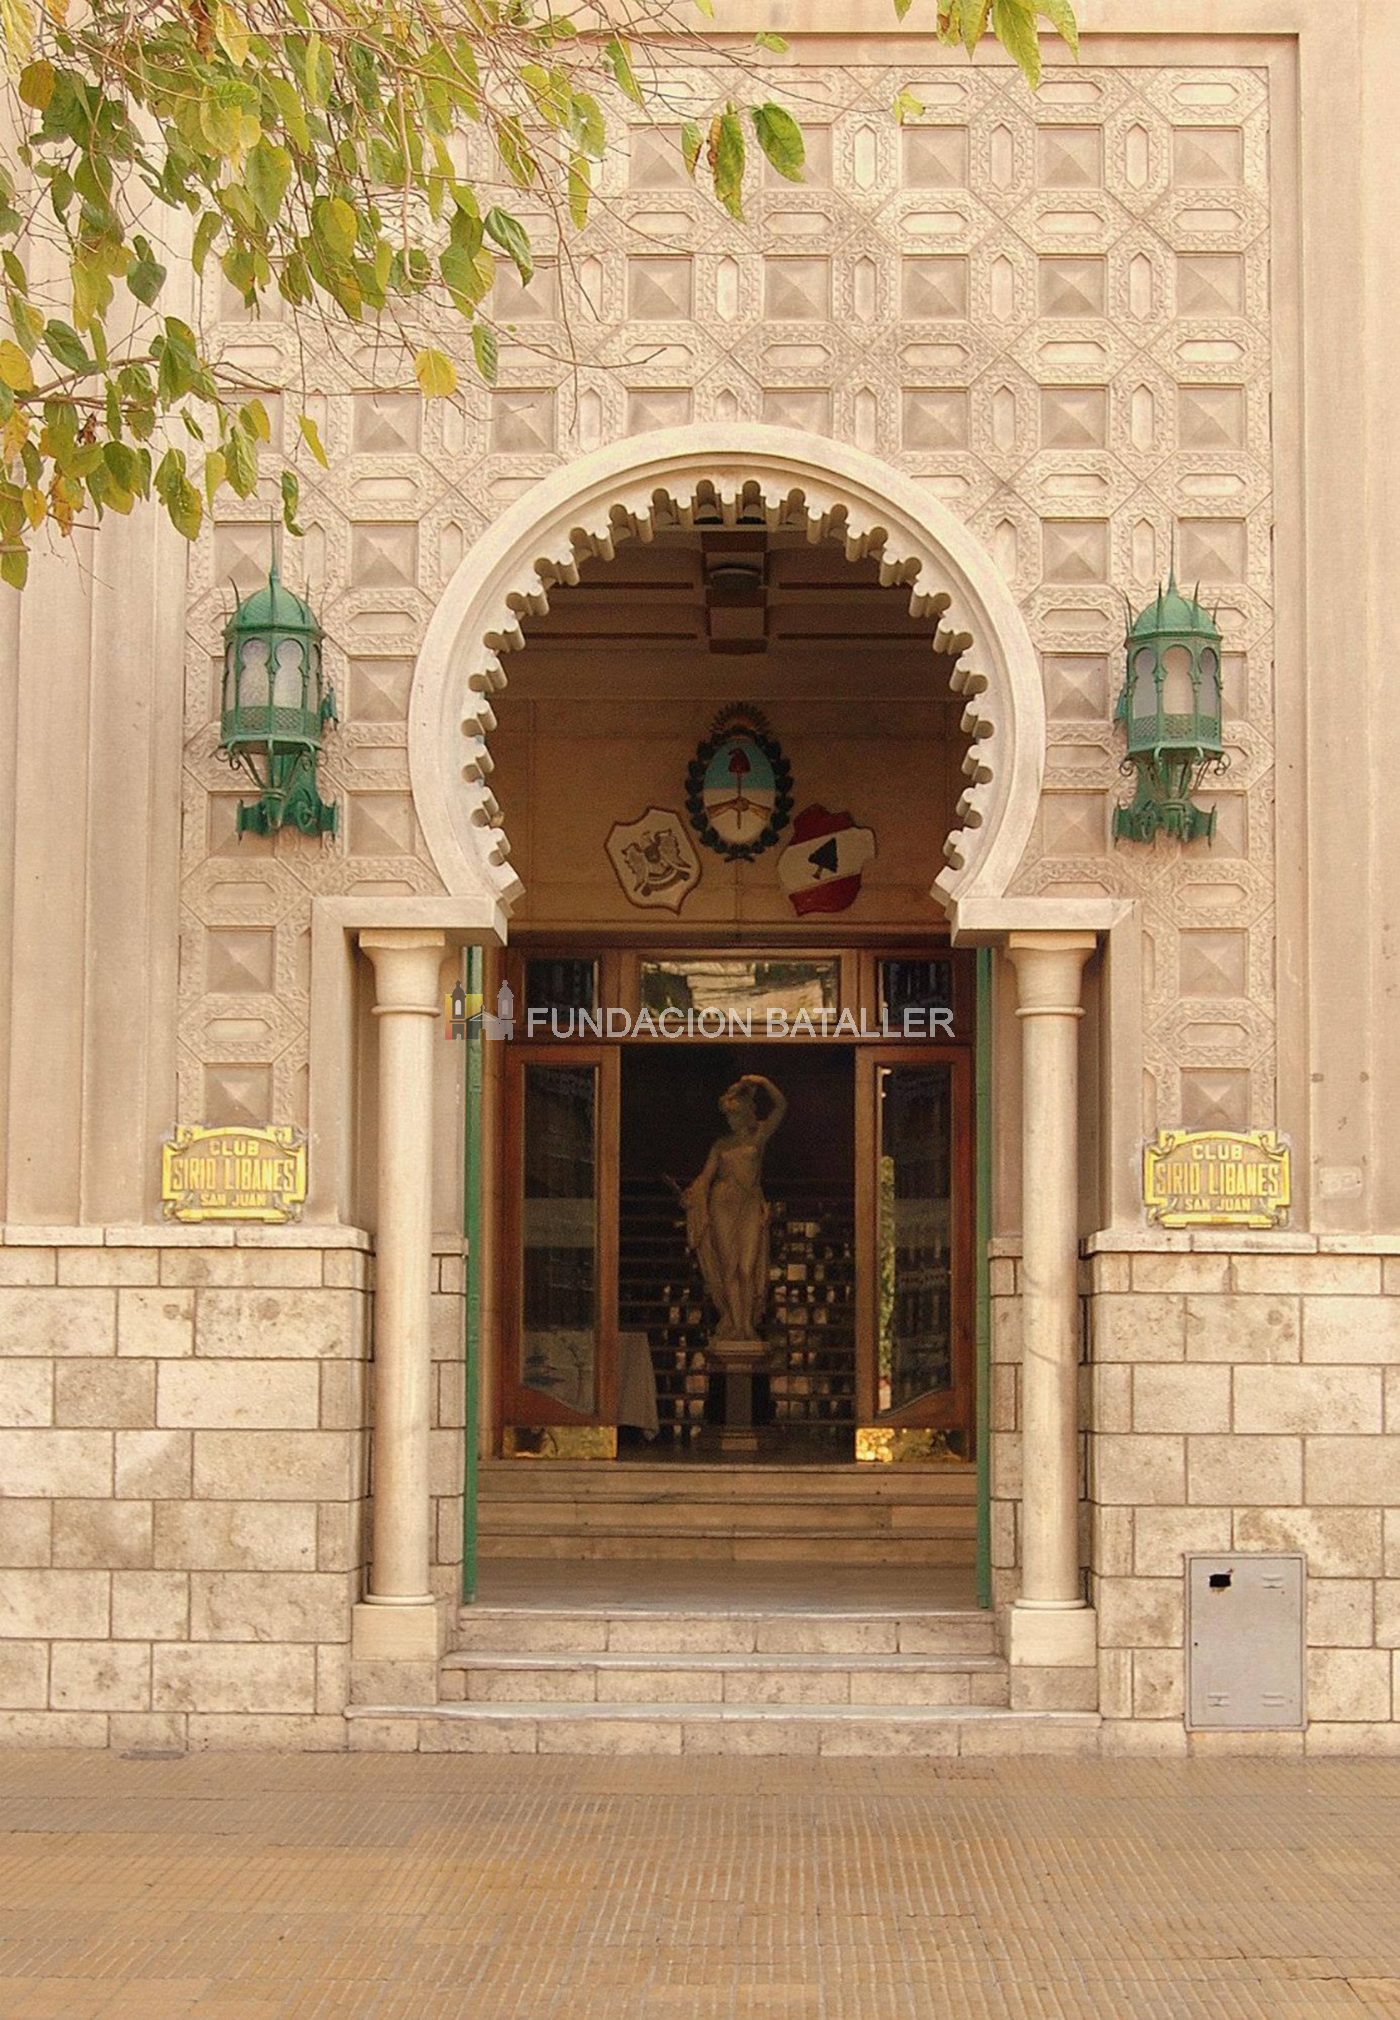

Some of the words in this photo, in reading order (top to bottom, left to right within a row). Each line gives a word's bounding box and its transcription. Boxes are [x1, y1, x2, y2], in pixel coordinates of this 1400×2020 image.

[209, 1140, 260, 1156] CLUB
[1192, 1144, 1243, 1160] CLUB
[172, 1158, 216, 1191] SIRIO
[224, 1158, 294, 1192] LIBANES
[1156, 1162, 1200, 1195] SIRIO
[1208, 1162, 1279, 1196] LIBANES
[200, 1193, 227, 1206] SAN
[232, 1193, 266, 1206] JUAN
[1185, 1198, 1210, 1211] SAN
[1216, 1198, 1251, 1211] JUAN
